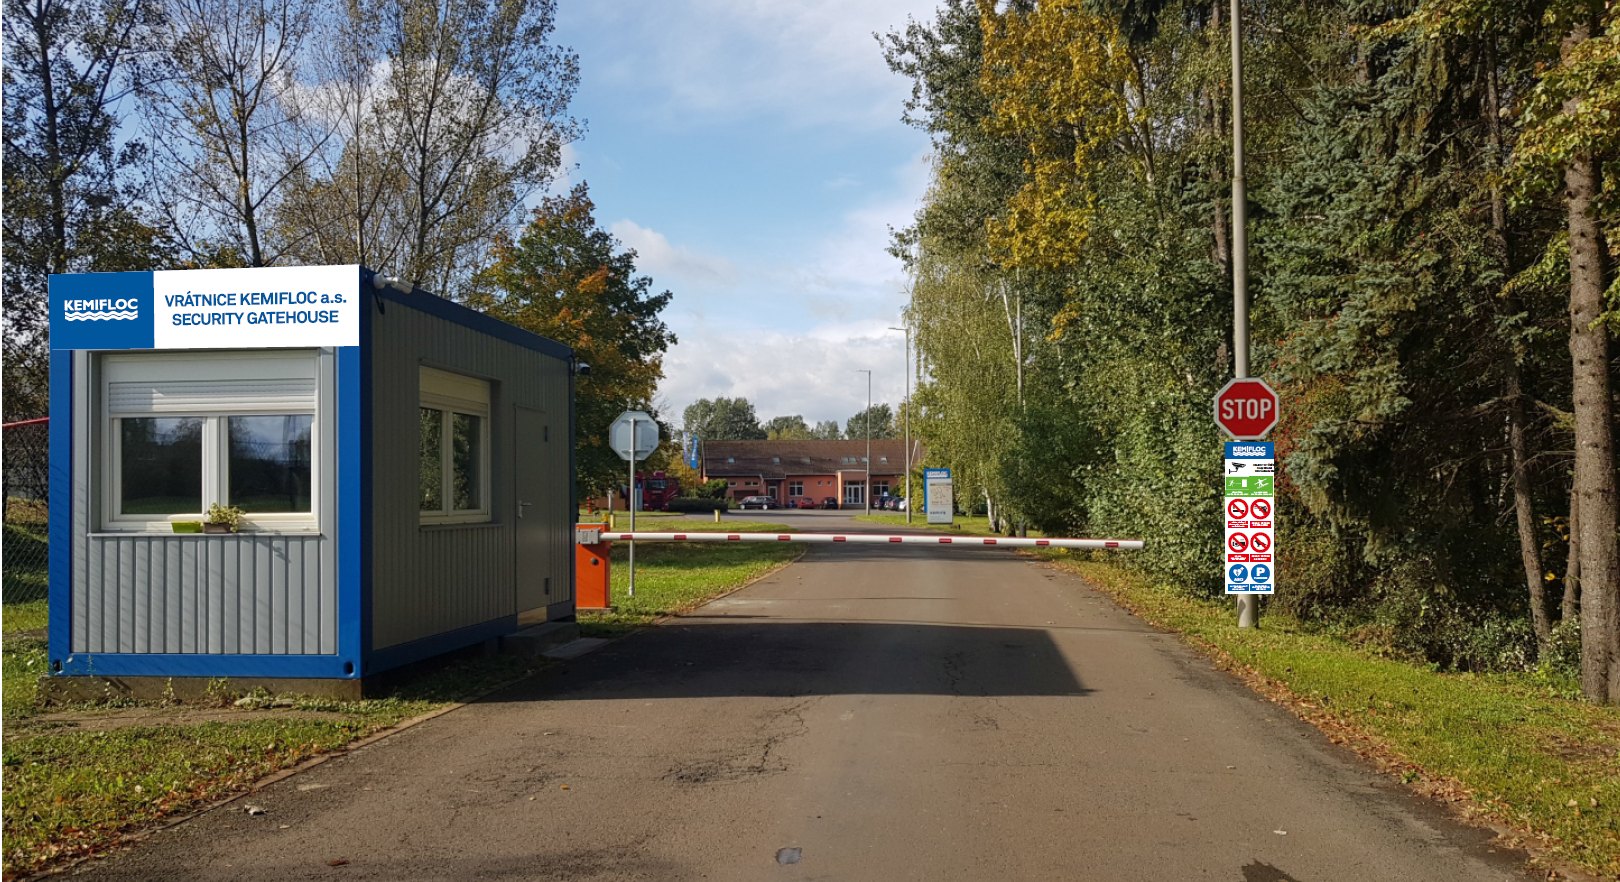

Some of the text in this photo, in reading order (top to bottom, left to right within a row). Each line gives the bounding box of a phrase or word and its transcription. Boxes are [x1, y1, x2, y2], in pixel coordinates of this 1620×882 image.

[64, 298, 138, 311] KEMIFLOC
[165, 291, 347, 307] VRÁTNICE KEMIFLOC a.s.
[172, 310, 339, 326] SECURITY GATEHOUSE
[1222, 398, 1272, 420] STOP
